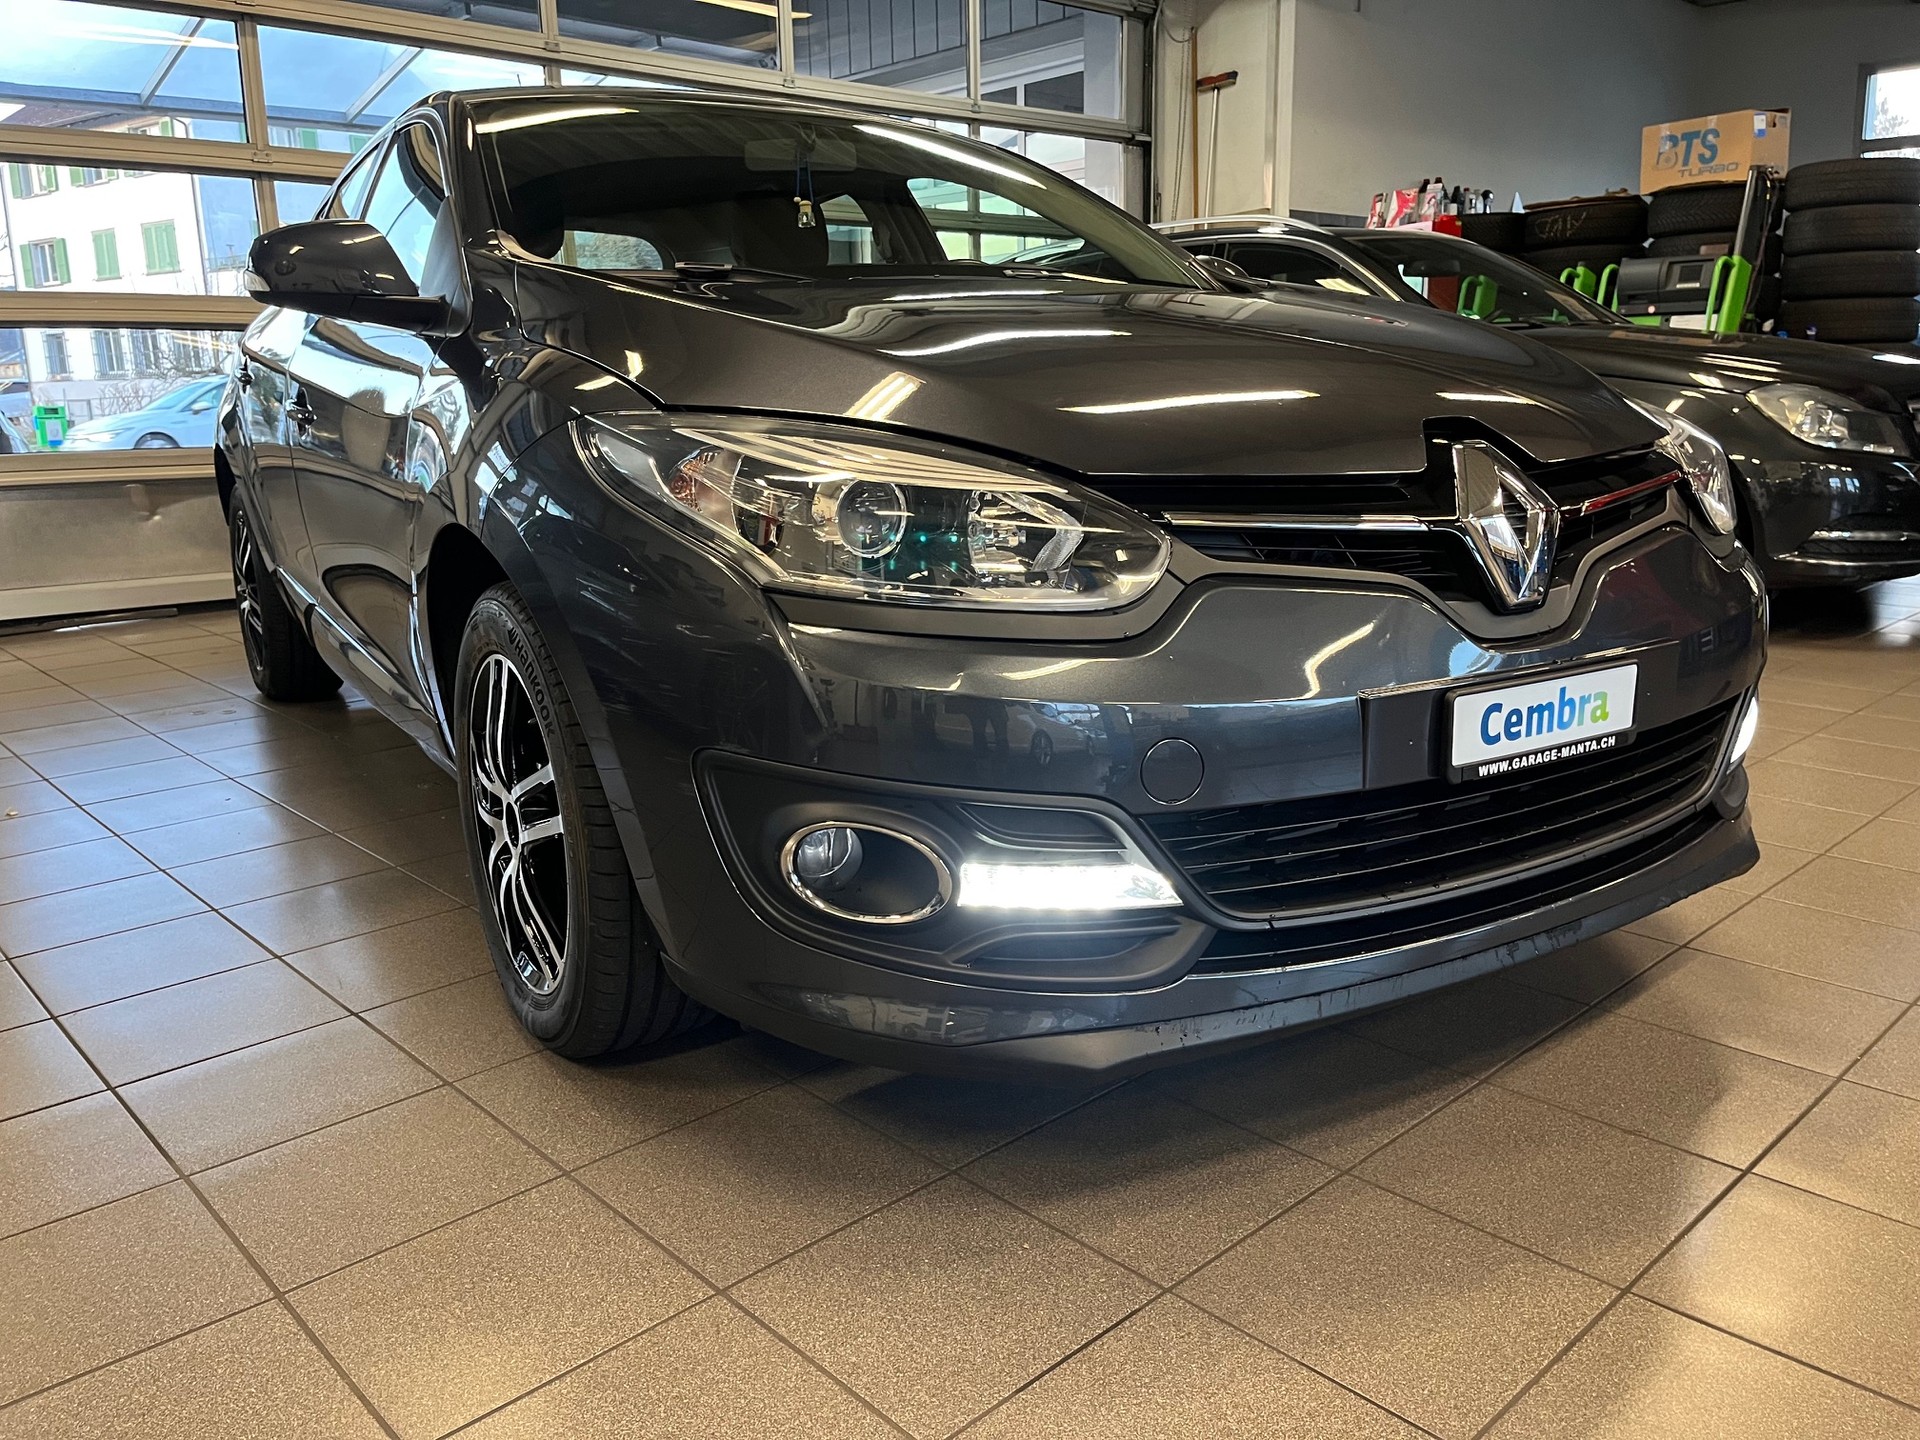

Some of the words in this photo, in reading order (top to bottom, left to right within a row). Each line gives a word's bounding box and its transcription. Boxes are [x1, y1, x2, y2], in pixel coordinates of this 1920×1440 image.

[1655, 128, 1721, 169] BTS
[1480, 686, 1609, 746] Cembra
[1478, 735, 1616, 777] WWW.GARAGE-MANTA.CH
